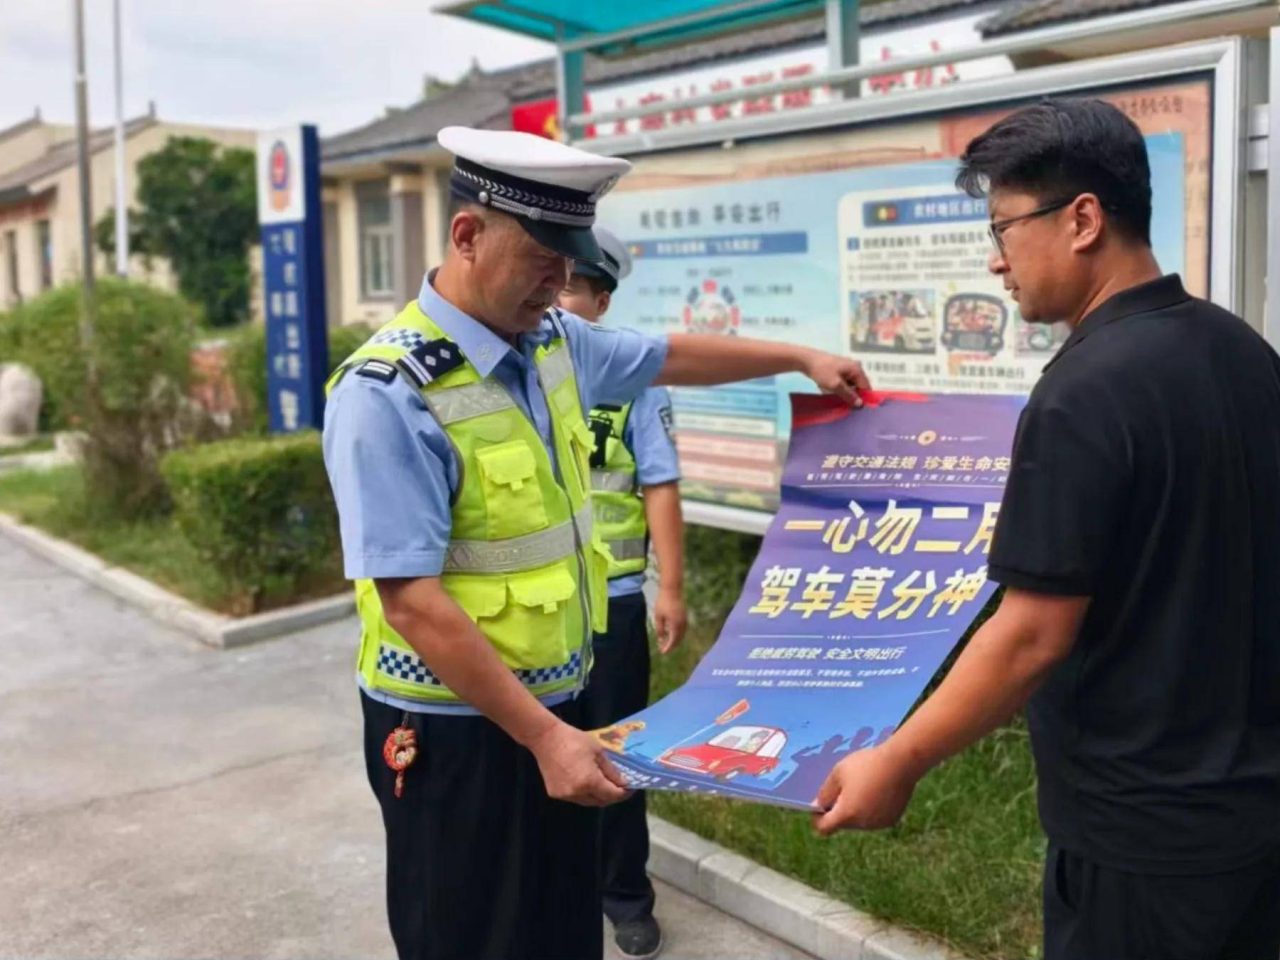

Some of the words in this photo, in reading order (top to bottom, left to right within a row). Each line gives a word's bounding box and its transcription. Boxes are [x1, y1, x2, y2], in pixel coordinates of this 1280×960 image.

[820, 454, 917, 471] 遵守交通法规
[748, 564, 988, 621] 驾车莫分神
